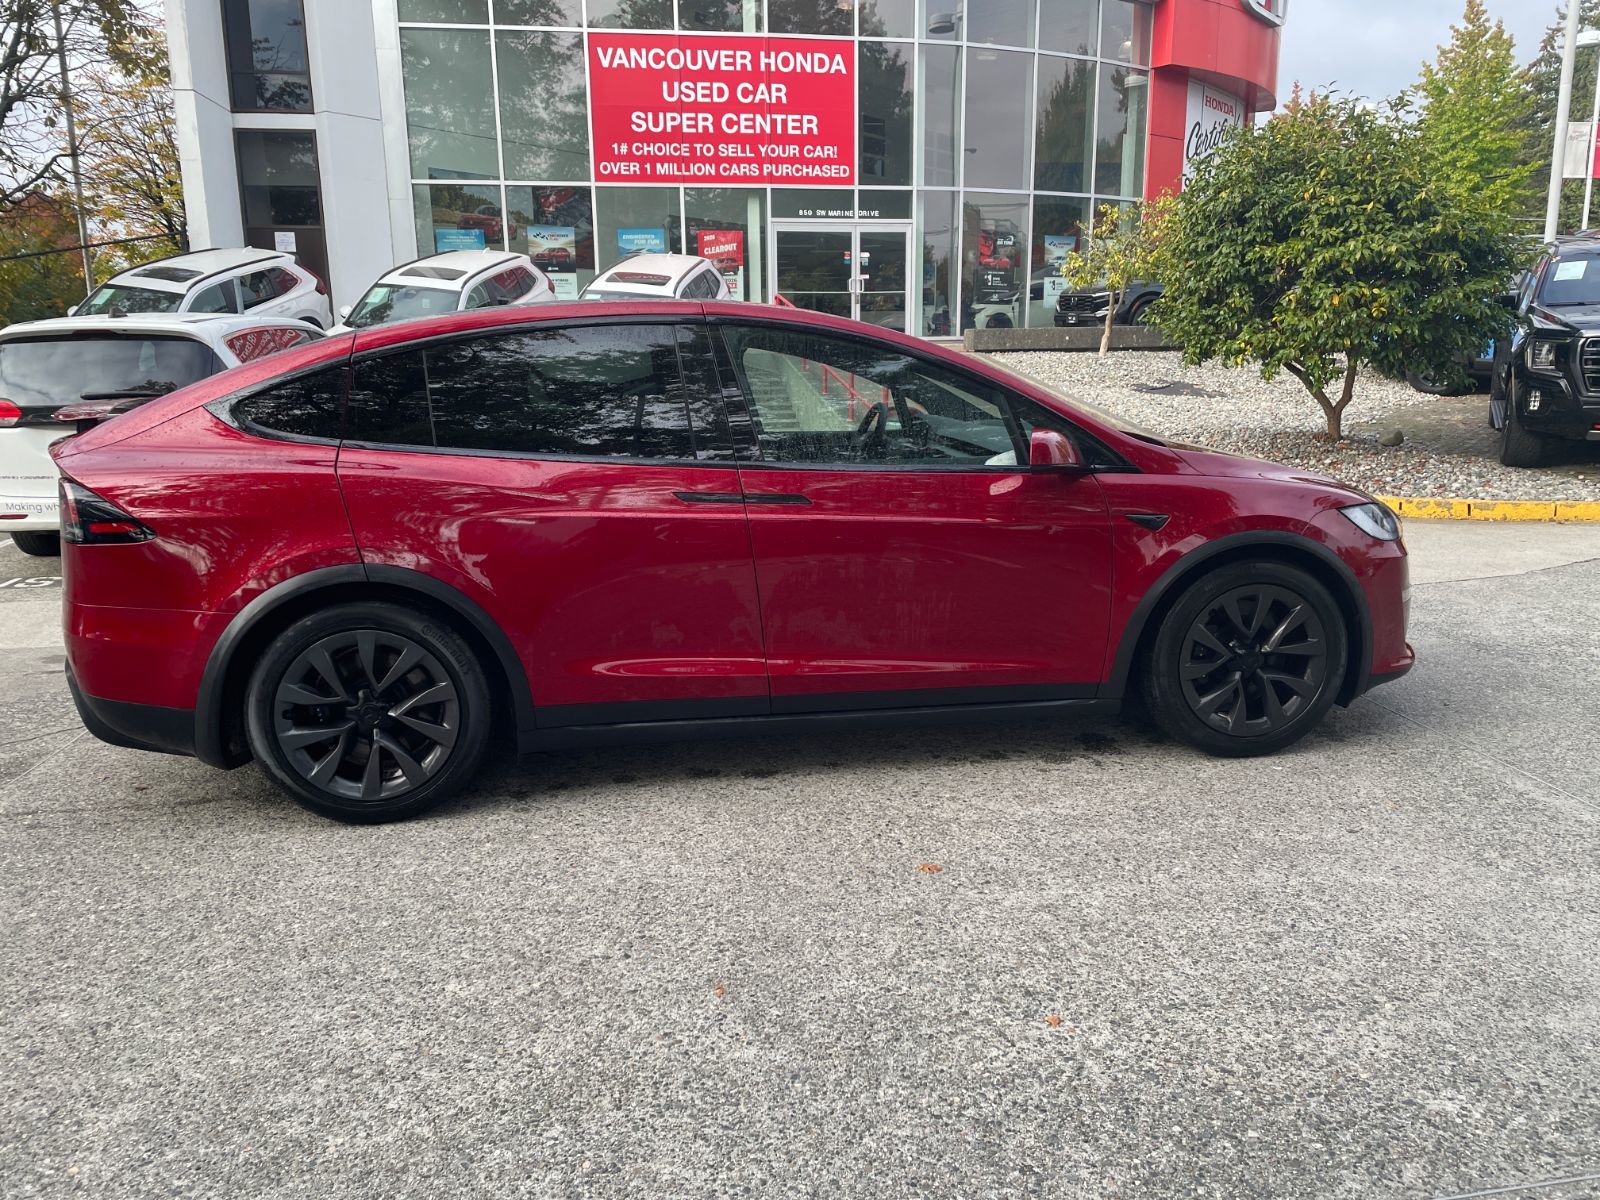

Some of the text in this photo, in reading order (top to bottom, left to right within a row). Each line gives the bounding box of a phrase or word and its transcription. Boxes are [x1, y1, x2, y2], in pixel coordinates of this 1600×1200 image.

[596, 46, 847, 75] VANCOUVER HONDA
[662, 81, 787, 104] USED CAR
[1204, 95, 1234, 117] HONDA
[631, 111, 819, 135] SUPER CENTER
[611, 142, 838, 158] 1# CHOICE TO SELL YOUR CAR!
[599, 161, 850, 178] OVER 1 MILLION CARS PURCHASED
[703, 243, 737, 255] CLEAROUT
[5, 502, 42, 514] Making
